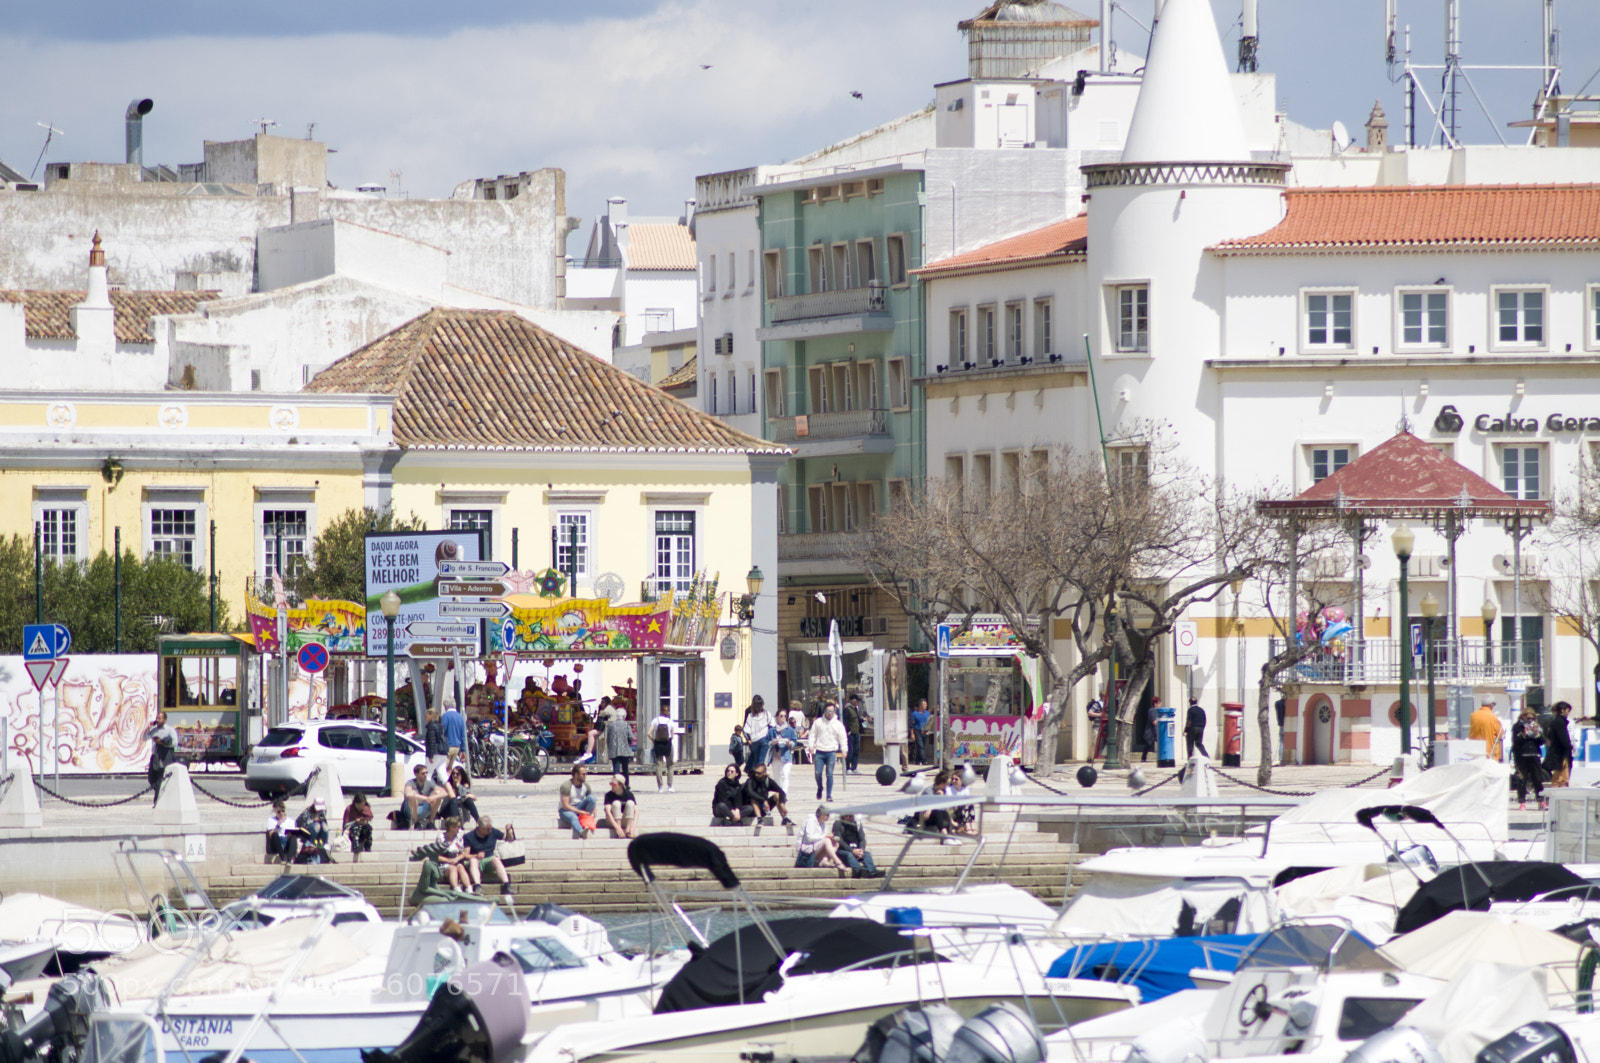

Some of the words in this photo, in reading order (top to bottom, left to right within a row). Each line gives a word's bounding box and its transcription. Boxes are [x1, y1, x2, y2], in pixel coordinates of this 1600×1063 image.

[1475, 413, 1539, 433] Caixa
[371, 541, 393, 552] DAQUI
[395, 540, 419, 551] AGORA
[371, 552, 397, 568] VÊ-SE
[399, 553, 419, 566] BEM
[371, 568, 420, 584] MELHOR!
[448, 605, 471, 613] câmara
[472, 606, 502, 614] municipal
[371, 613, 425, 626] CONTE-NOS!
[436, 625, 467, 633] Pontinha
[800, 617, 823, 638] CASA
[423, 645, 443, 653] teatro
[180, 1035, 209, 1047] FARO
